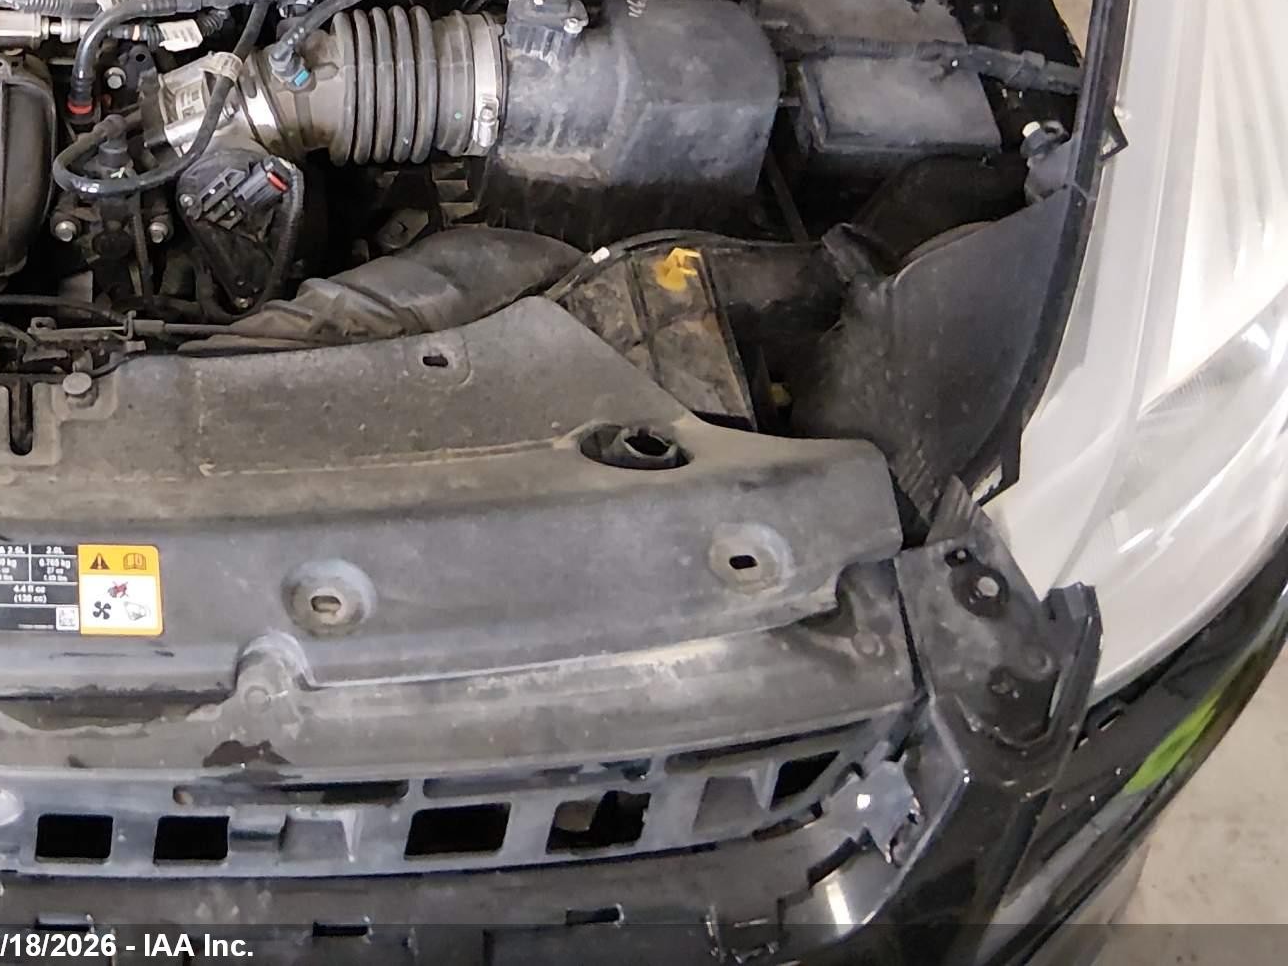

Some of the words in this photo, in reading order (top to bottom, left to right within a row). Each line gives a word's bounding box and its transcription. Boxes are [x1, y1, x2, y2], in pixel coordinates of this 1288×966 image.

[46, 546, 64, 555] 2.0L
[13, 585, 26, 593] 4.4
[33, 594, 47, 603] cc)
